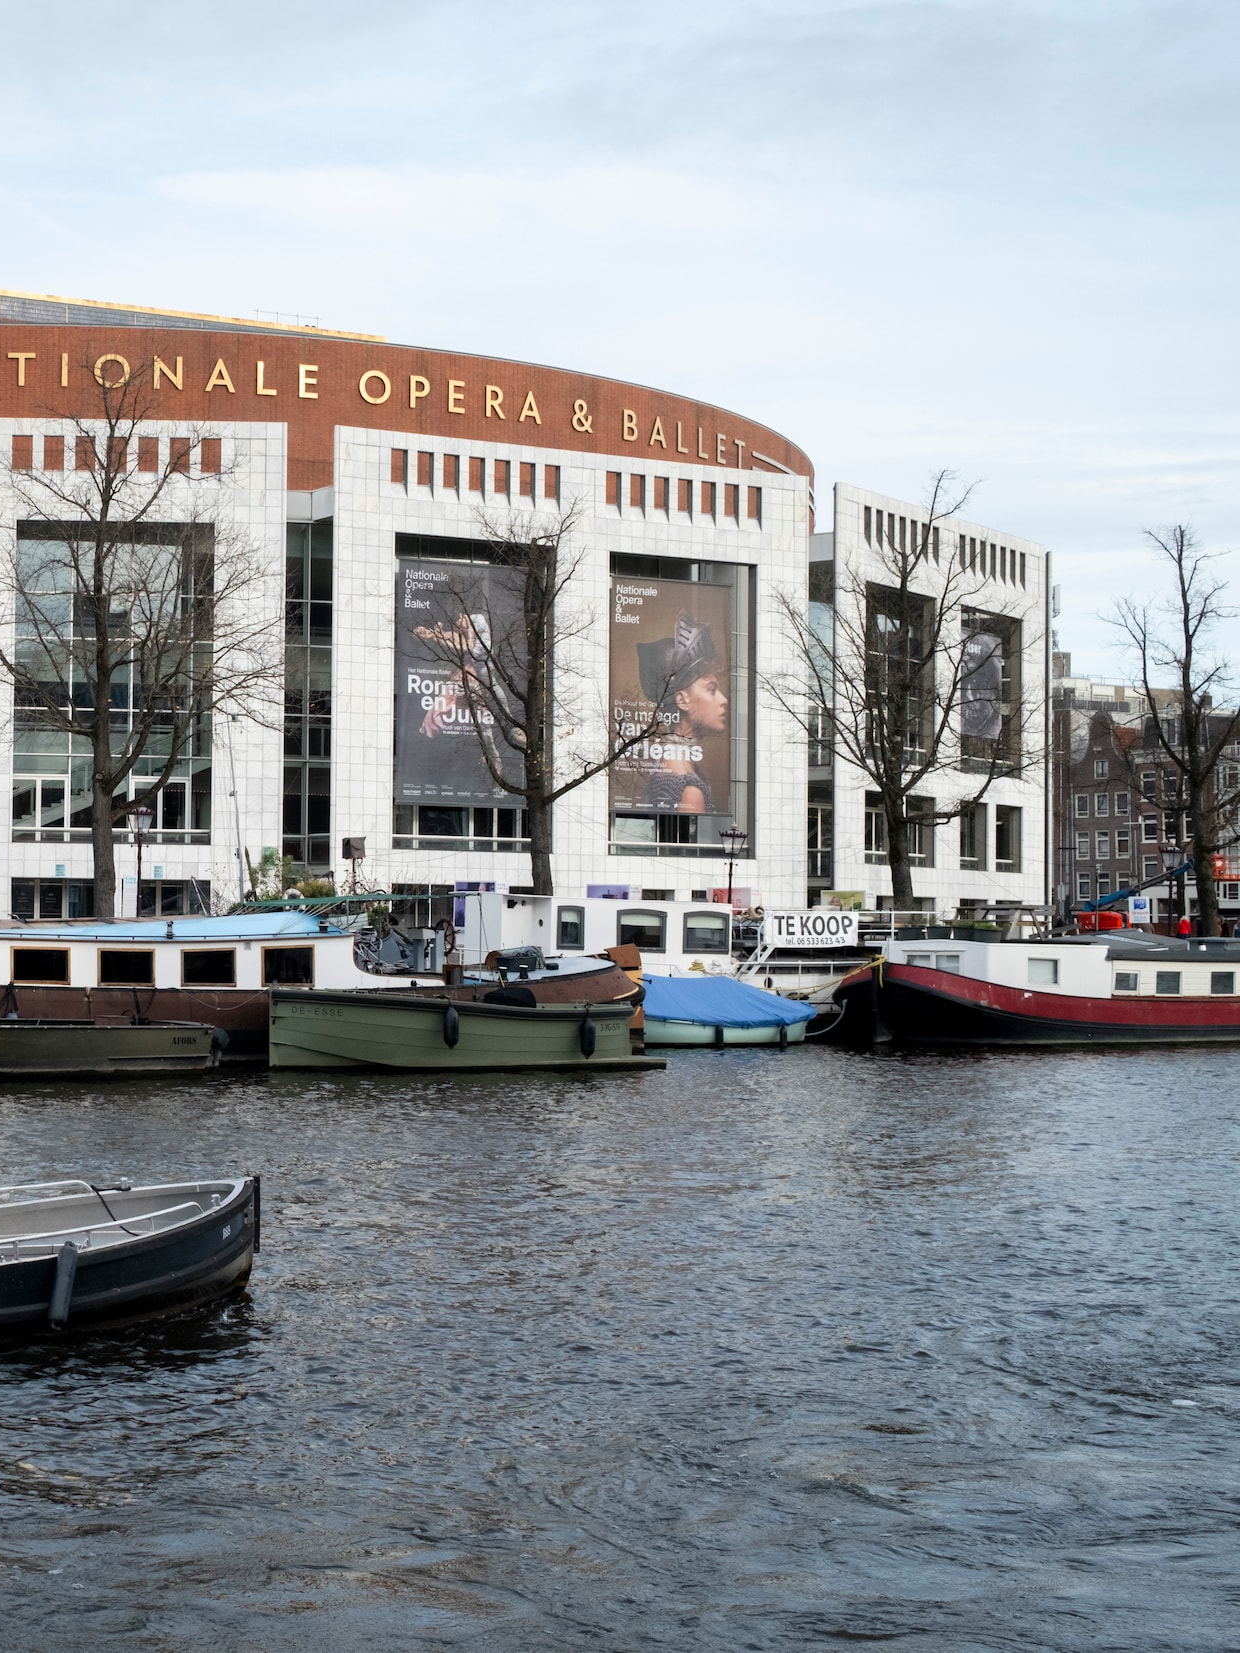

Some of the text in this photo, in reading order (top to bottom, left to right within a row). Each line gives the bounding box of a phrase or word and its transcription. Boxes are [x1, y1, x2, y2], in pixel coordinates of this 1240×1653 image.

[359, 369, 542, 425] OPERA
[572, 399, 593, 434] &
[623, 409, 745, 468] BALLET
[405, 569, 449, 582] Nationale
[405, 579, 434, 591] Opera
[616, 584, 658, 597] Nationale
[404, 598, 430, 609] Ballet
[615, 594, 643, 606] Opera
[615, 603, 622, 613] &
[615, 613, 640, 624] Ballet
[421, 695, 447, 711] en
[614, 707, 680, 725] De maagd
[773, 915, 853, 935] TE KOOP
